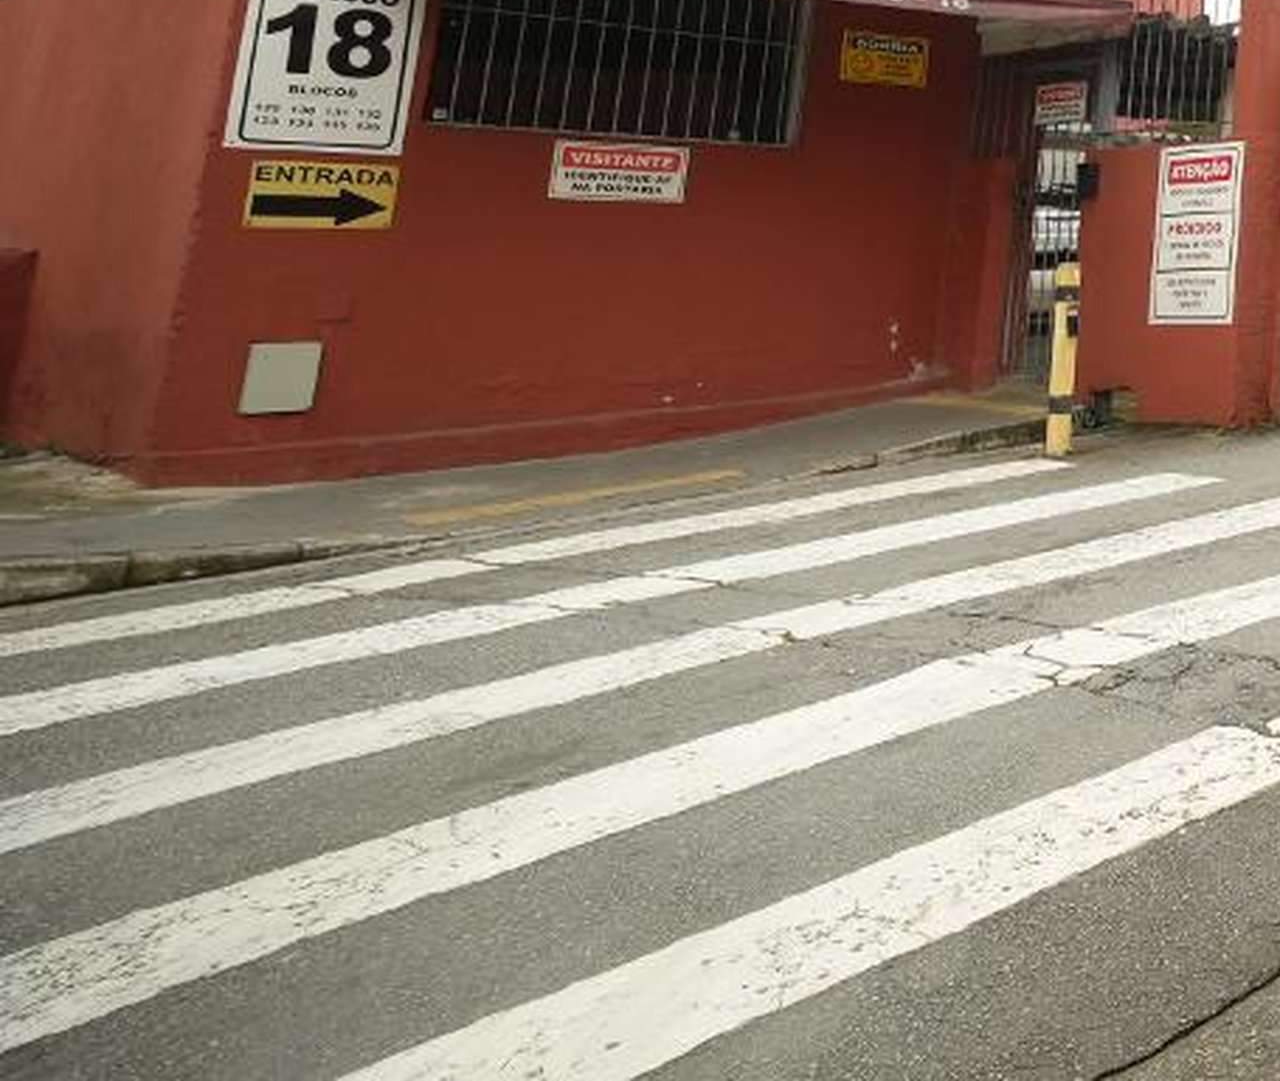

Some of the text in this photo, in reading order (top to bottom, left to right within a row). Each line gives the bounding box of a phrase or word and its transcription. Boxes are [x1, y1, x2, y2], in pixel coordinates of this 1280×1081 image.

[265, 2, 394, 80] 18
[287, 84, 358, 99] BLOCOS
[569, 151, 676, 168] VISITANTE
[255, 166, 394, 186] ENTRADA
